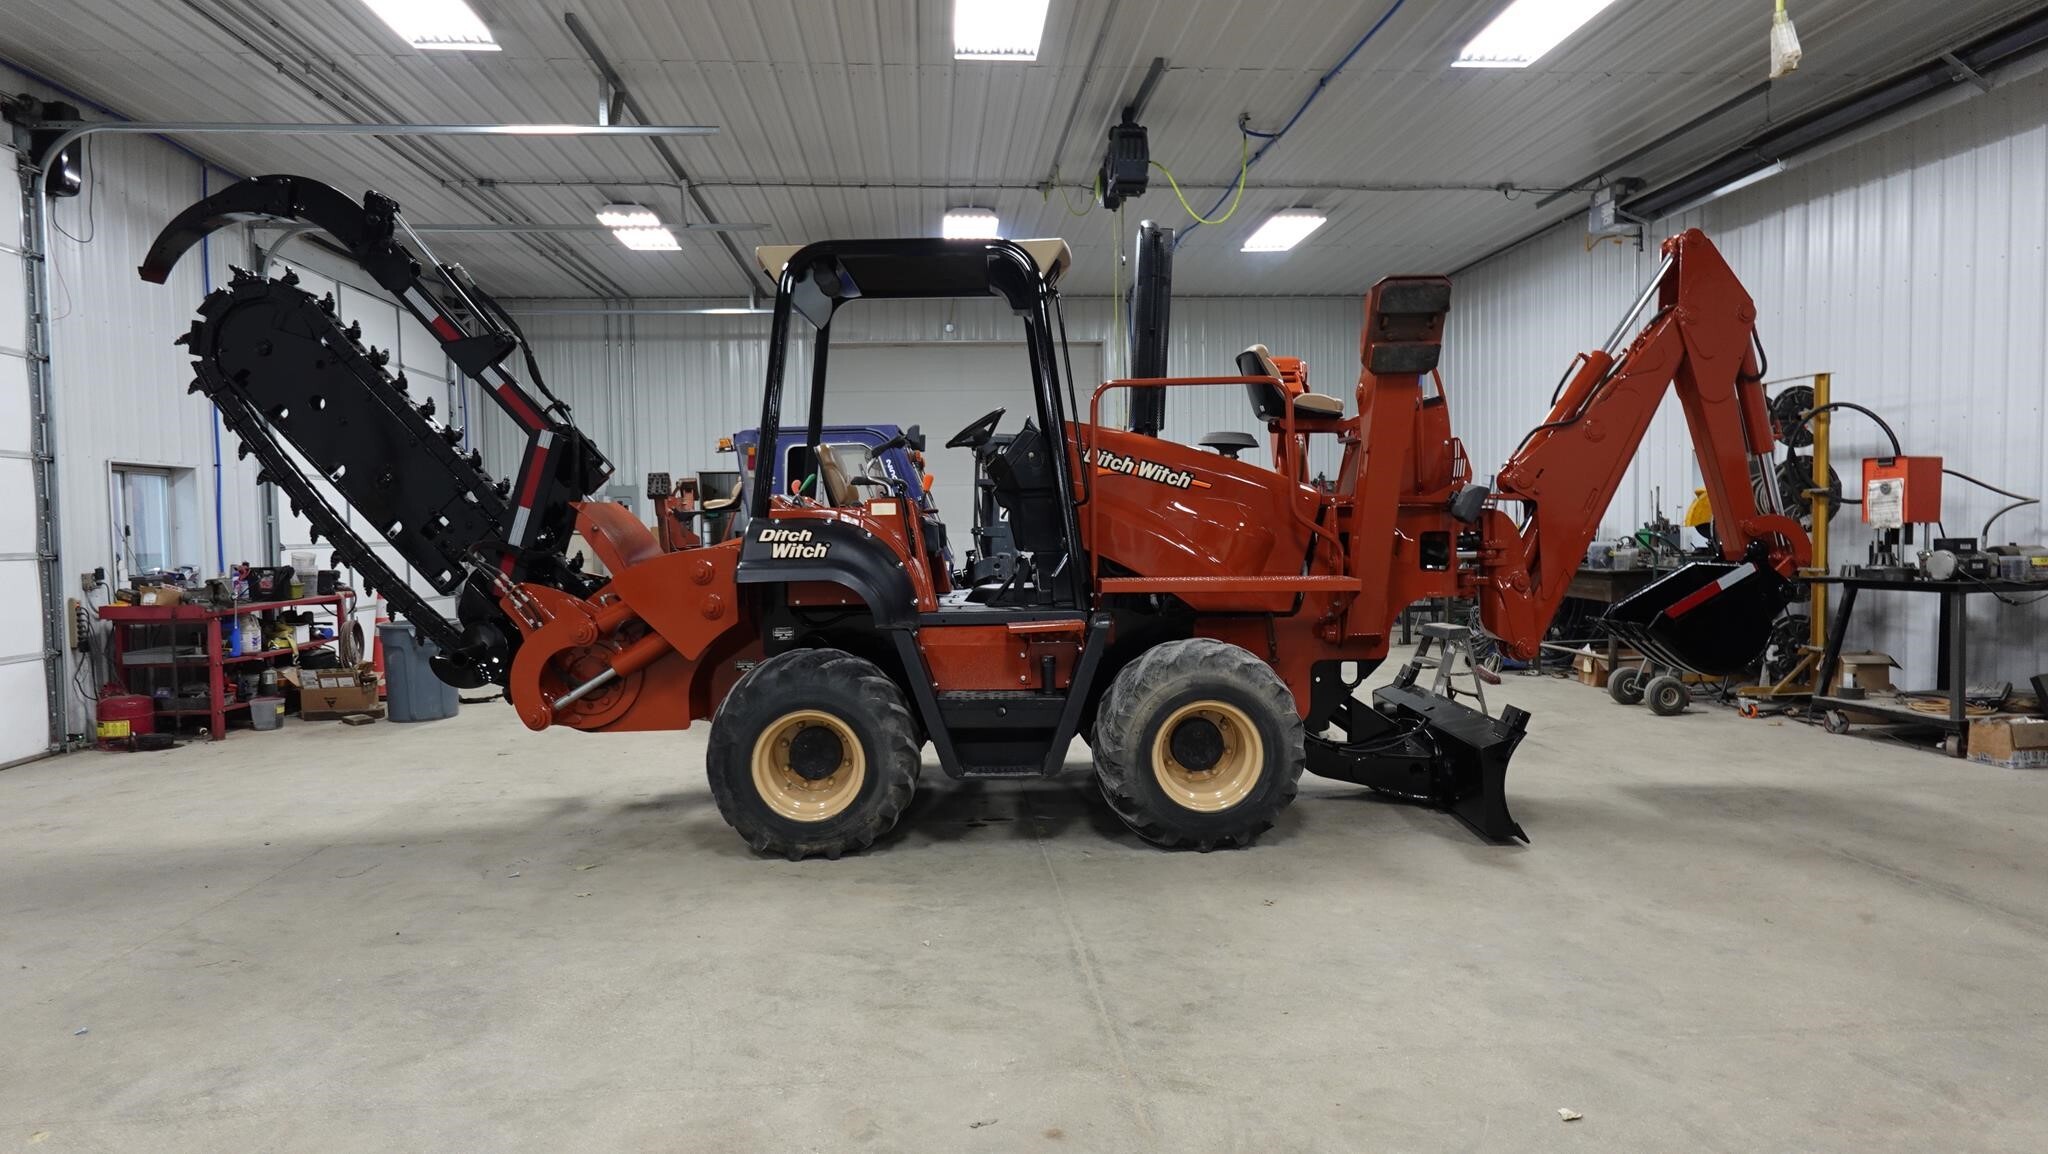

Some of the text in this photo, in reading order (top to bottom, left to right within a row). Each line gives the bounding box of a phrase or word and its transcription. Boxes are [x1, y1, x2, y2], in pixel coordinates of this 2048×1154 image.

[1137, 461, 1192, 488] Witch
[758, 529, 813, 542] Ditch
[772, 543, 828, 558] Witch
